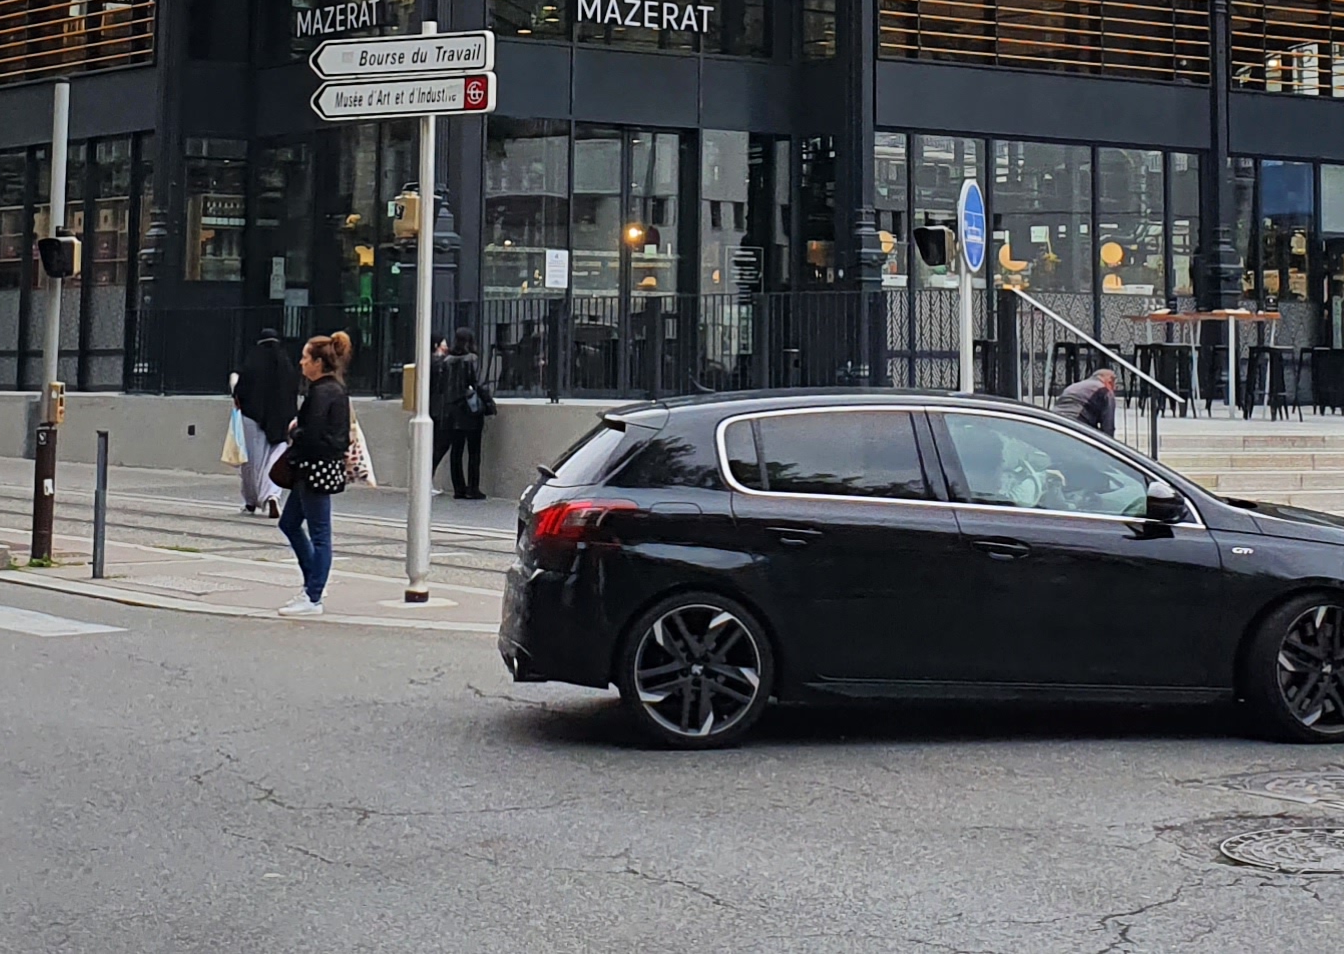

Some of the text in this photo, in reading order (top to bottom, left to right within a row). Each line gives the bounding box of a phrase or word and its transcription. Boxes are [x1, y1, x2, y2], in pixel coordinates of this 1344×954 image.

[359, 44, 482, 66] Bourse du Travail
[335, 91, 364, 108] Musée
[368, 89, 391, 106] d'Art
[395, 90, 404, 105] et
